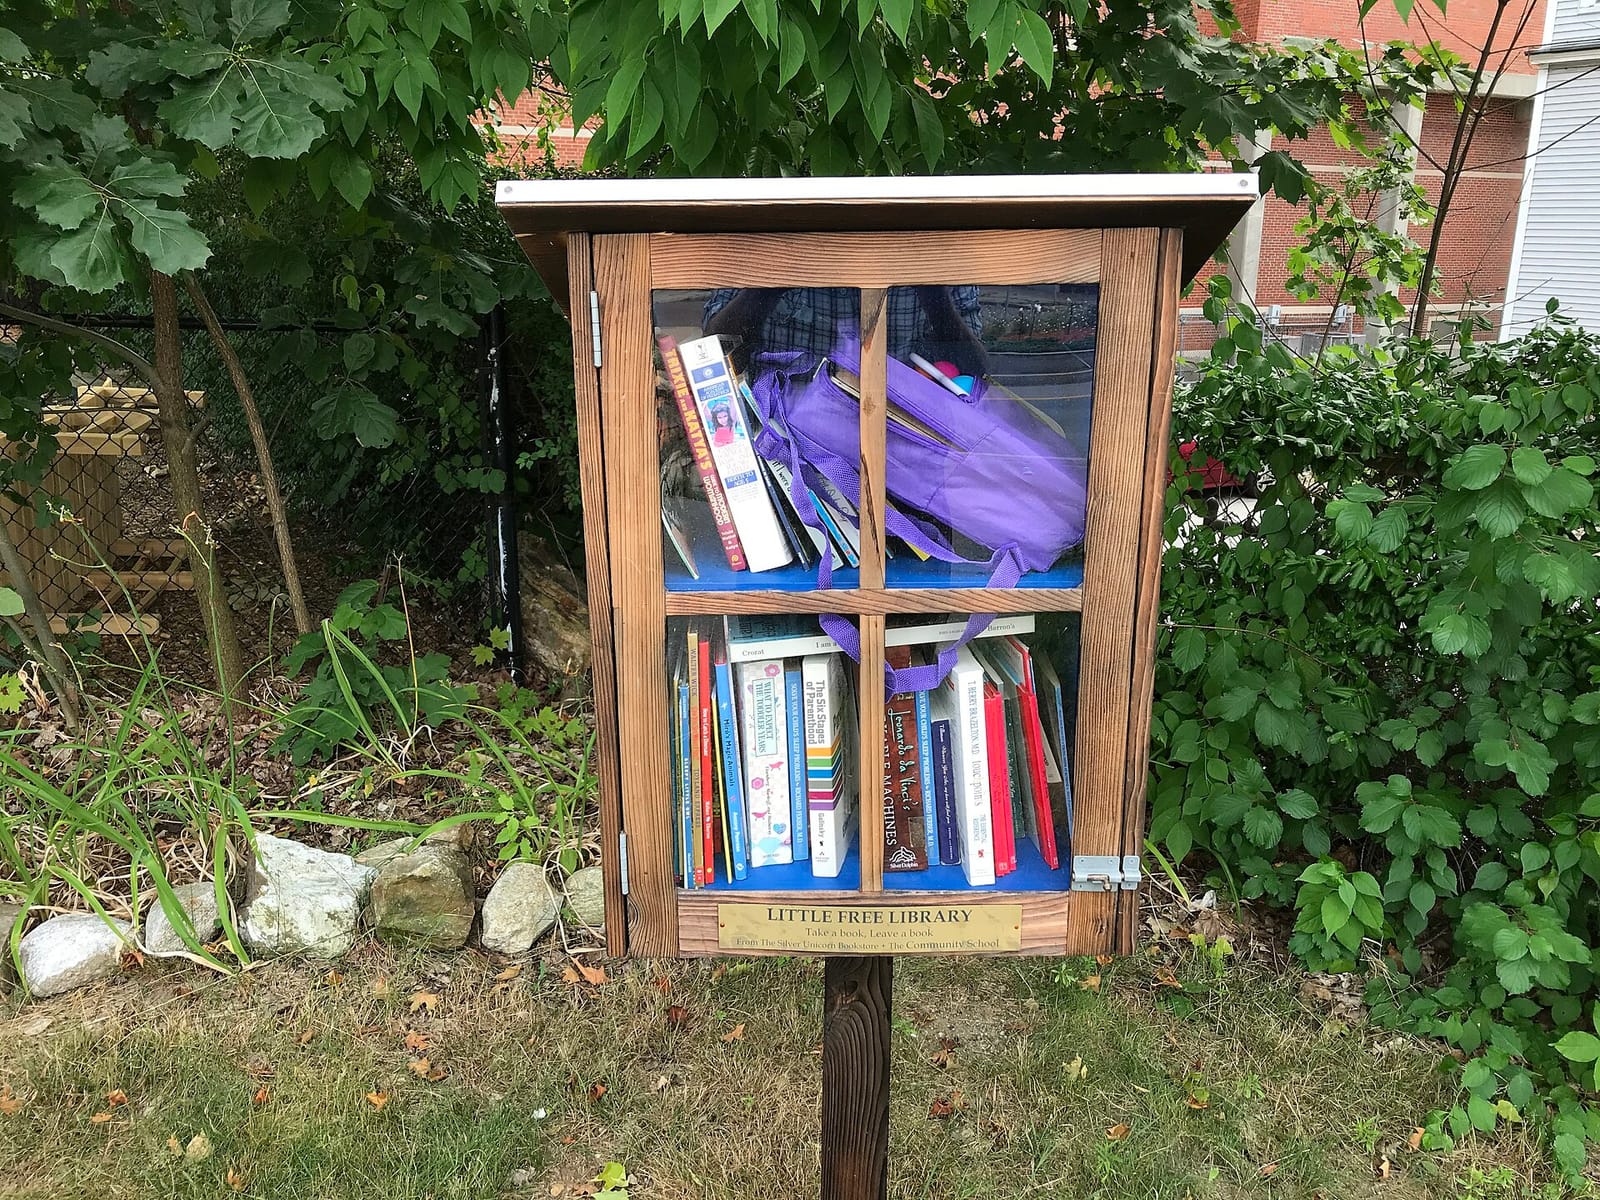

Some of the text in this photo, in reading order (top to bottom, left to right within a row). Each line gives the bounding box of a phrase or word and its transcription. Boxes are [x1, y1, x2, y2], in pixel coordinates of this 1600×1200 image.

[665, 348, 690, 398] TRIXIE
[684, 409, 713, 471] KATYA'S
[779, 472, 789, 485] were
[987, 623, 1016, 632] Barron's
[742, 649, 765, 657] Crozat
[968, 686, 977, 706] BERRY
[755, 683, 766, 753] THE TODDLER YEARS
[764, 681, 774, 740] WHAT TO EXPECT
[791, 701, 799, 716] YOUR
[806, 681, 818, 745] of Parenthood
[816, 680, 827, 744] The Six Stages
[888, 707, 919, 811] Leonardo da Vinci's
[884, 774, 897, 846] MACHINES
[817, 813, 825, 837] Galinsky
[767, 908, 973, 924] LITTLE FREE LIBRARY
[805, 928, 829, 937] Take
[840, 928, 867, 938] book,
[870, 929, 899, 938] Leave
[909, 928, 934, 938] book
[761, 939, 776, 947] The
[777, 939, 801, 948] Silver
[803, 940, 836, 949] Unicorn
[838, 941, 879, 950] Bookstore
[890, 942, 903, 950] The
[906, 940, 965, 951] Community
[967, 939, 1000, 949] School
